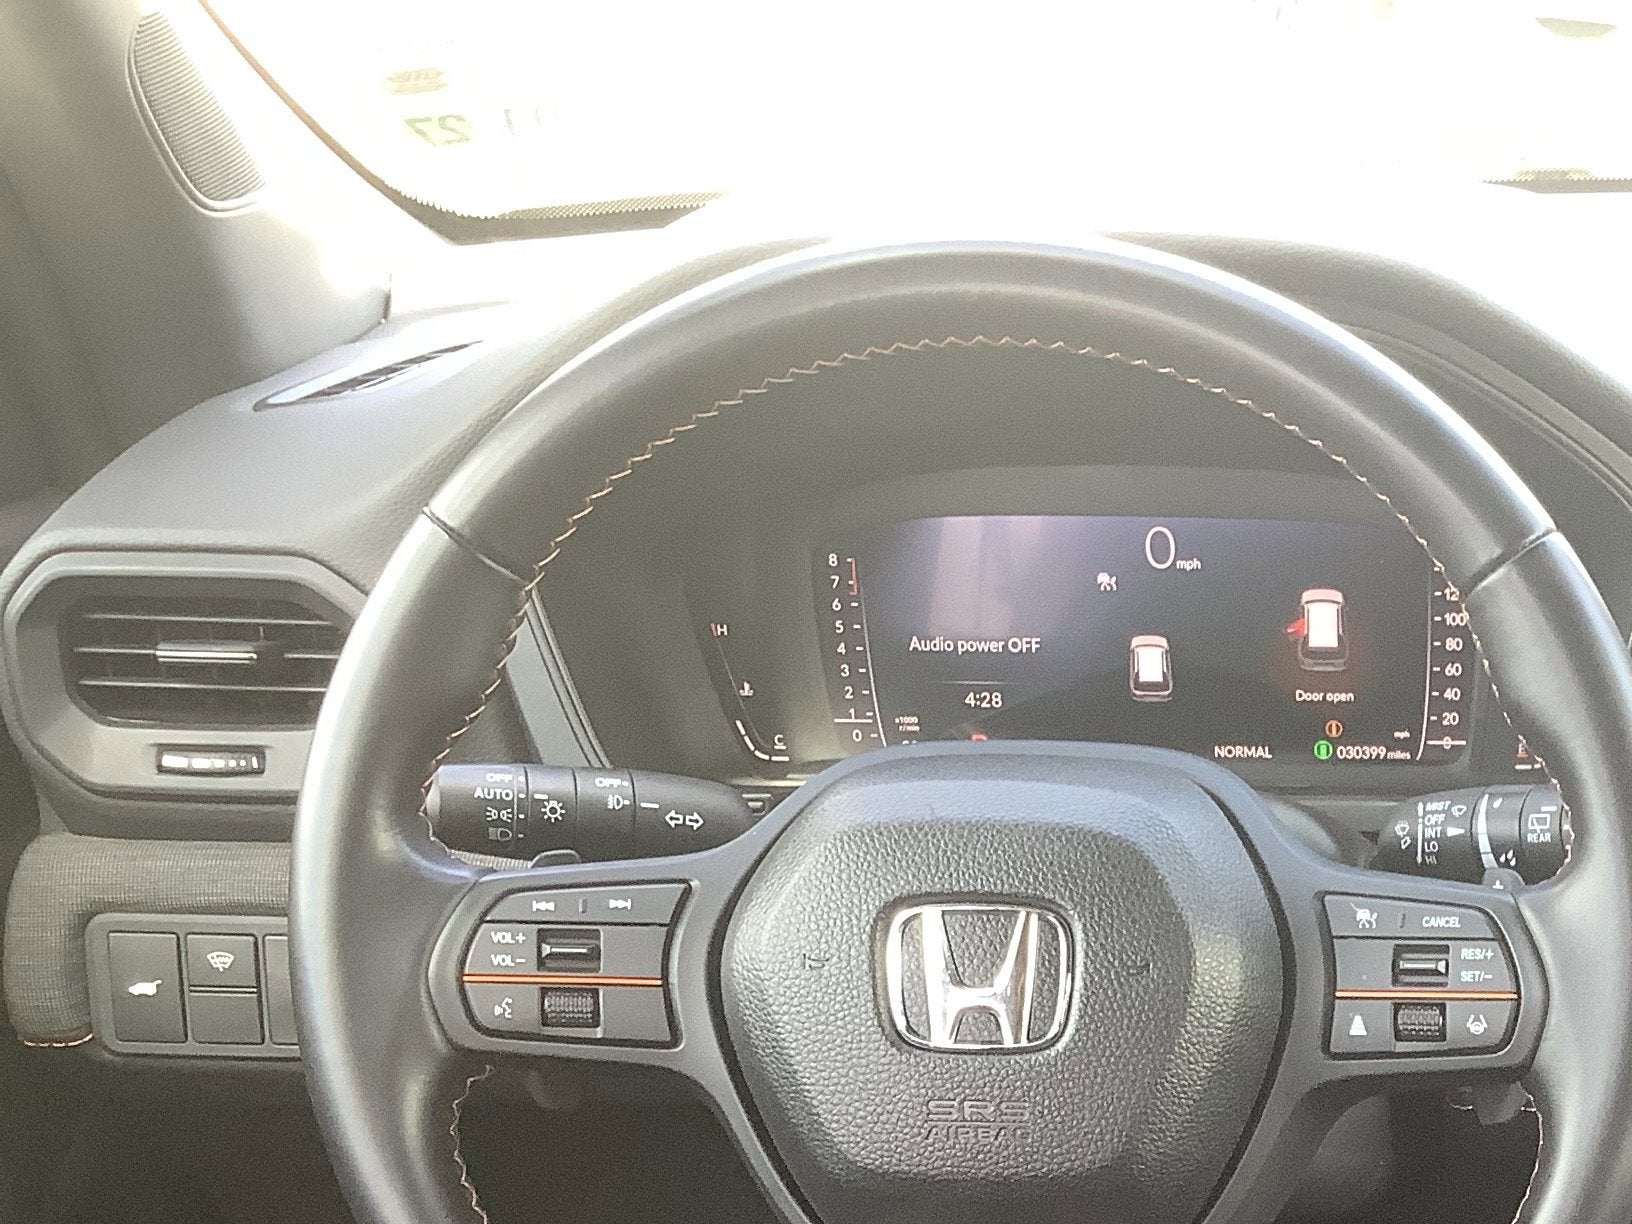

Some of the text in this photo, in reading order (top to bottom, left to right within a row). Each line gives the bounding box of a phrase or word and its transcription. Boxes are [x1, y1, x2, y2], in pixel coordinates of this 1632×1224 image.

[1145, 526, 1201, 571] 0 mph
[828, 554, 838, 567] 8
[831, 576, 840, 589] 7
[1443, 589, 1460, 601] 12
[832, 598, 841, 611] 6
[1444, 613, 1467, 626] 100
[717, 624, 728, 636] H
[835, 620, 844, 633] 5
[837, 643, 846, 655] 4
[909, 636, 1041, 655] Audio power OFF
[1445, 637, 1463, 651] 80
[840, 664, 849, 677] 3
[1444, 663, 1462, 676] 60
[844, 686, 853, 699] 2
[1295, 689, 1354, 704] Door open
[1443, 688, 1461, 701] 40
[964, 692, 1003, 708] 4:28
[848, 708, 856, 720] 1
[1442, 712, 1459, 726] 20
[852, 730, 862, 742] 0
[1215, 746, 1272, 758] NORMAL
[1336, 746, 1387, 760] 030399
[486, 773, 513, 782] OFF
[595, 778, 622, 788] OFF
[474, 789, 513, 800] AUTO
[1425, 801, 1450, 811] MIST
[1425, 814, 1445, 826] OFF
[1424, 826, 1442, 838] INT
[1527, 833, 1551, 843] REAR
[1424, 841, 1439, 852] LO
[1422, 917, 1461, 928] CANCEL
[927, 1100, 1030, 1121] SRS
